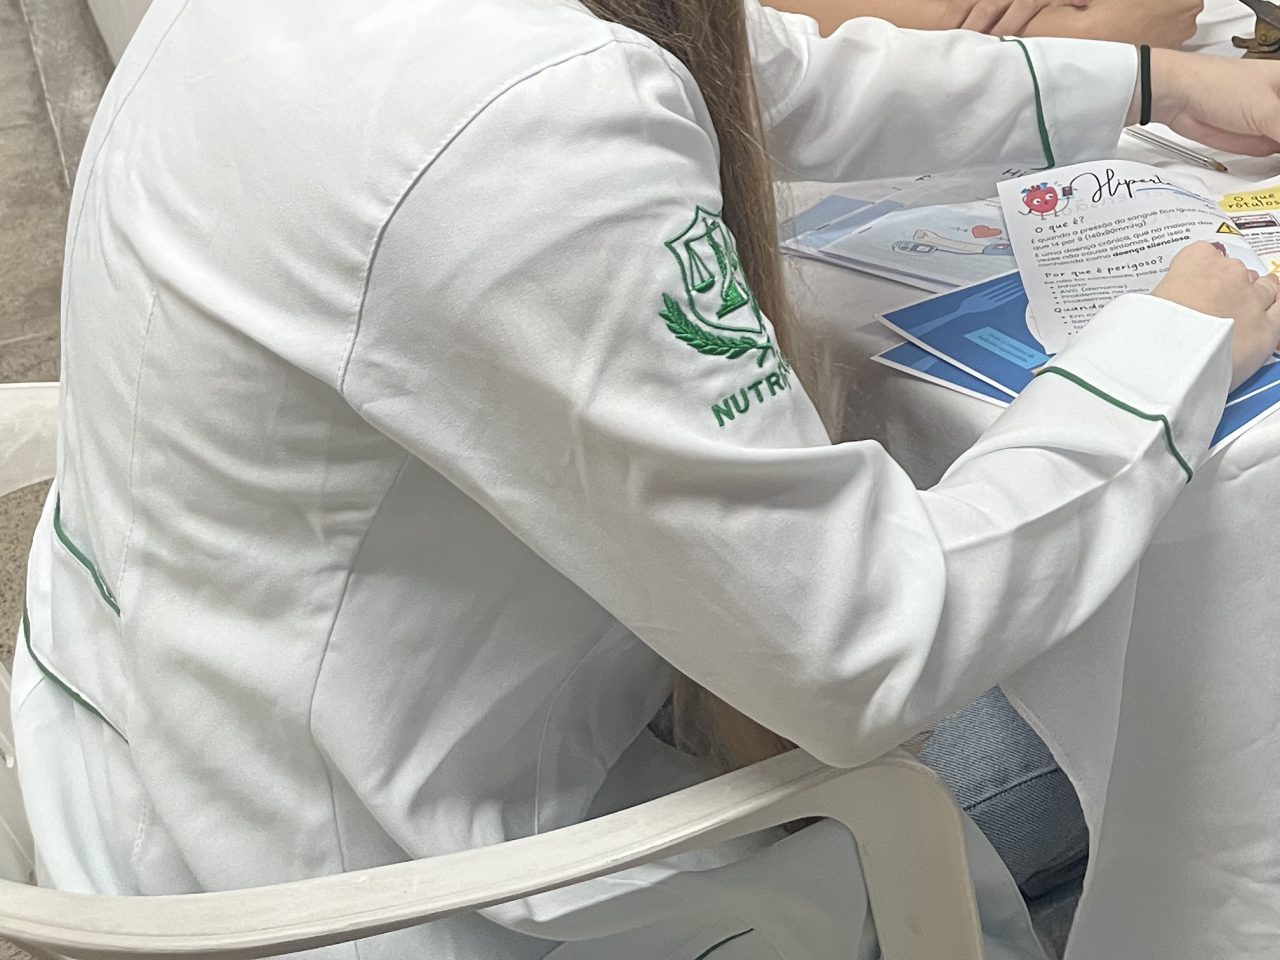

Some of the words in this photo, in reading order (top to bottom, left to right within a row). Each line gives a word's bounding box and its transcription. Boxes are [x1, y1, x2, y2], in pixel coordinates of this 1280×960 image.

[1228, 197, 1280, 209] rótulos
[1251, 193, 1275, 203] que
[1037, 232, 1071, 243] quando
[1080, 222, 1113, 234] pressão
[1127, 211, 1158, 222] sangue
[1048, 222, 1068, 233] que
[1061, 239, 1075, 247] por
[1084, 220, 1147, 241] (140x90mmHg)
[1063, 243, 1097, 255] doença
[1098, 236, 1132, 247] crônica,
[1133, 230, 1150, 239] que
[1163, 221, 1197, 230] maioria
[1081, 248, 1108, 257] causa
[1151, 233, 1166, 242] por
[1086, 254, 1111, 262] como
[1112, 245, 1146, 257] doença
[1147, 235, 1190, 249] silenciosa
[1071, 269, 1092, 278] que
[1107, 255, 1163, 275] perigoso?
[1136, 269, 1158, 277] pode
[1061, 291, 1110, 299] Problemas
[1054, 303, 1105, 313] Quando
[710, 371, 788, 427] NUTR
